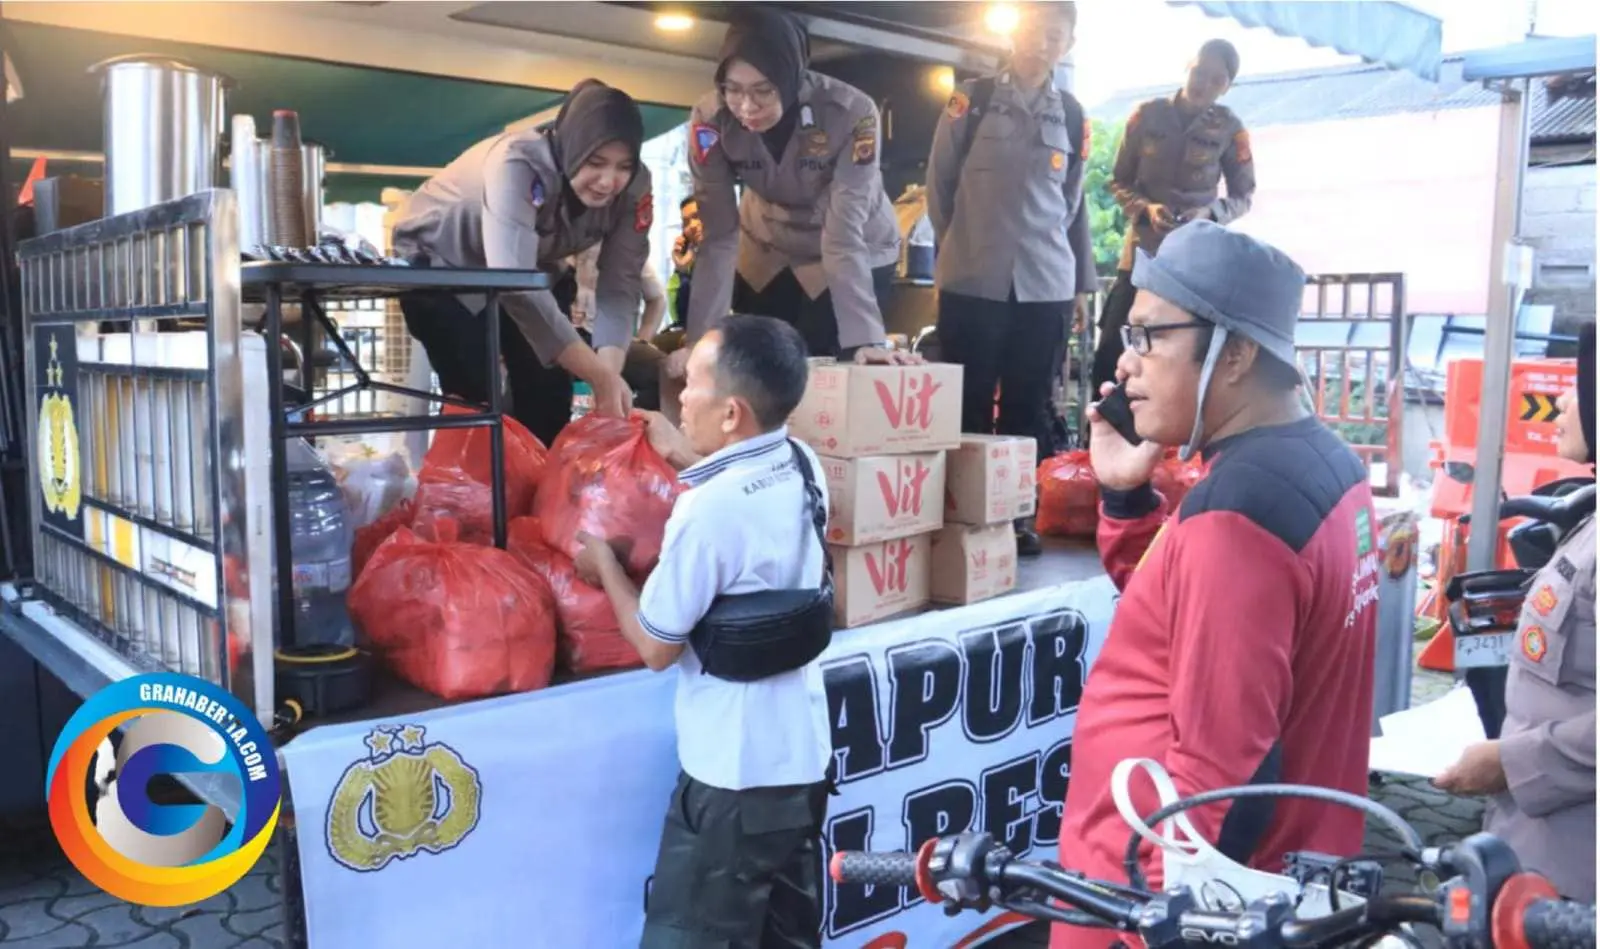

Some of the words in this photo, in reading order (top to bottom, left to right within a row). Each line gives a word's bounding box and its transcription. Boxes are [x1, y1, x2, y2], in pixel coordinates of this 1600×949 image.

[873, 370, 942, 430] Vit
[876, 457, 930, 519] Vit
[864, 538, 915, 596] Vit
